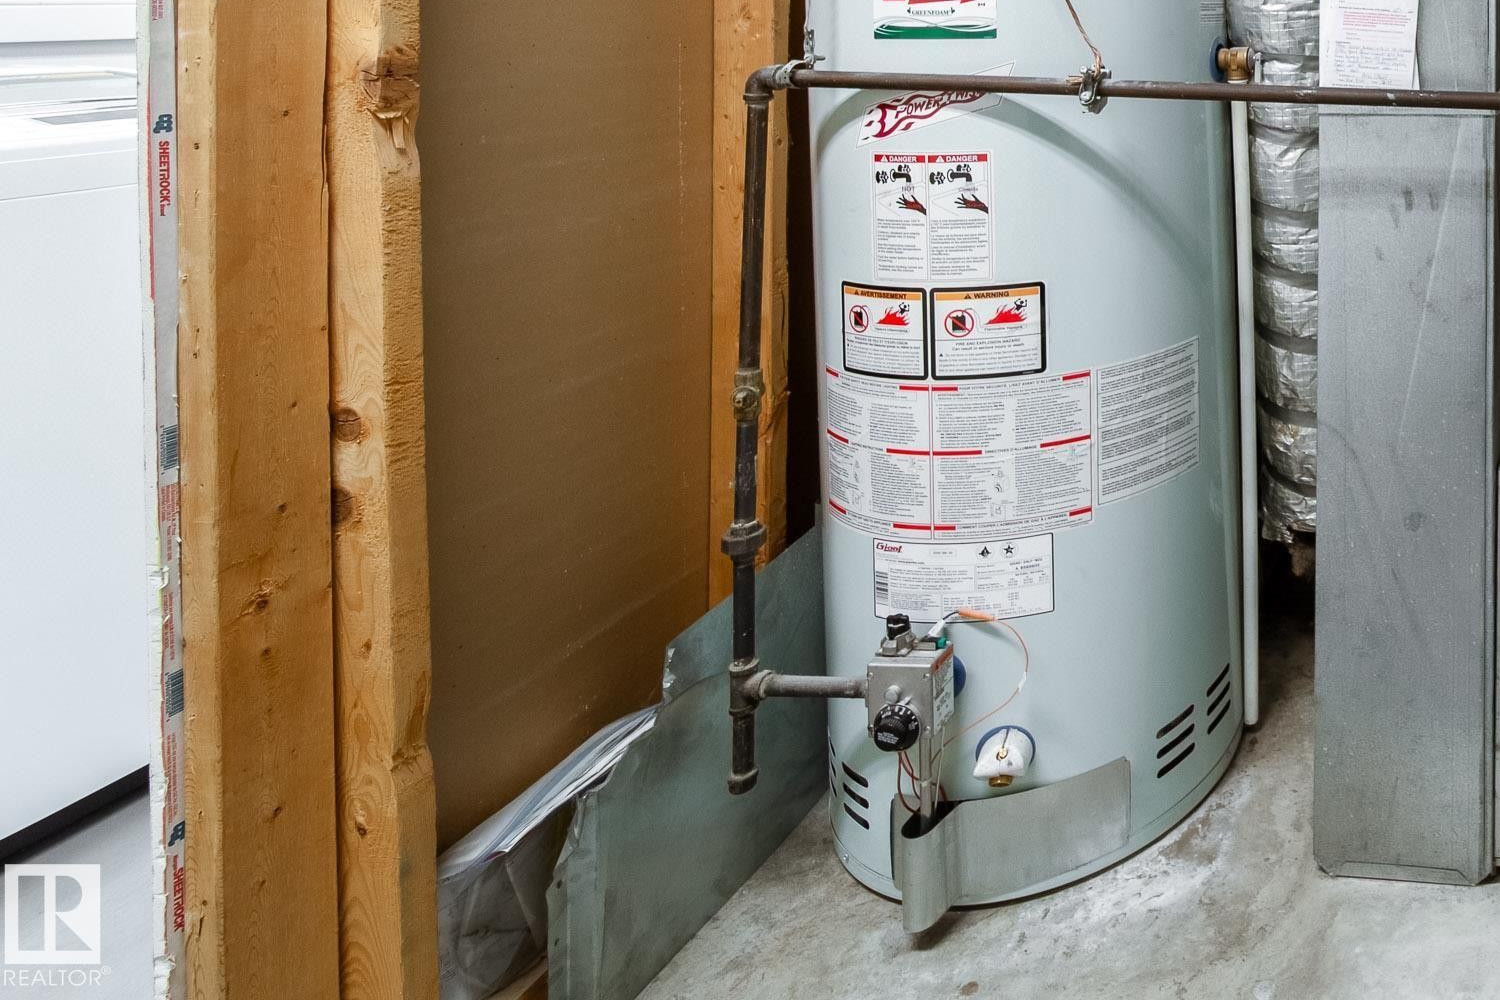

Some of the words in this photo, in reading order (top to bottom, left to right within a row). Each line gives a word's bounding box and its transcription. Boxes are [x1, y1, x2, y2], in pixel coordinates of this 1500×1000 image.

[895, 97, 943, 119] POWER
[158, 141, 171, 203] SHEETROCK
[860, 290, 907, 300] AVERTISSEMENT
[974, 291, 1010, 299] WARNING
[876, 542, 903, 553] Giant
